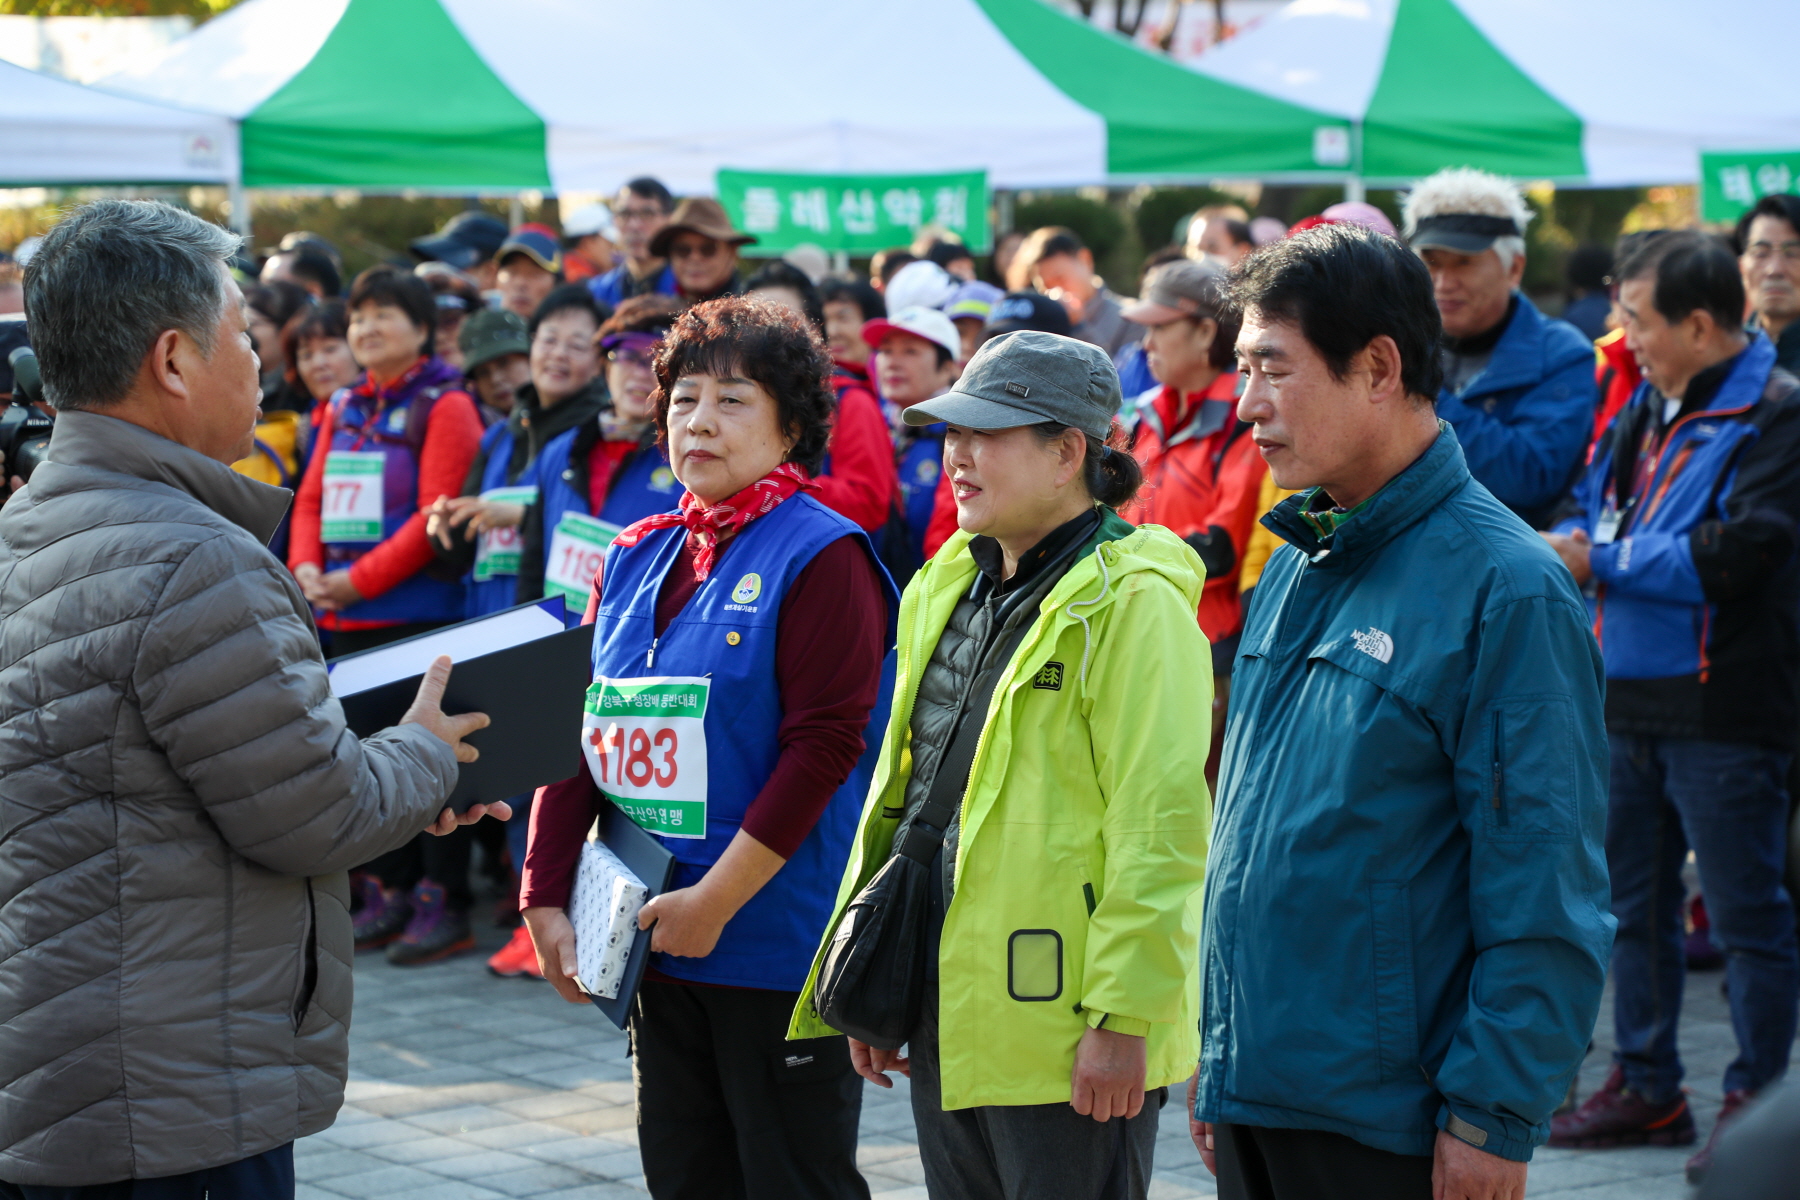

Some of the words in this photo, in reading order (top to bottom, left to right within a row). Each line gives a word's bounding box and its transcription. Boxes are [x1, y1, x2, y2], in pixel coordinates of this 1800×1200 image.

[1350, 629, 1380, 649] NORTH
[1369, 626, 1385, 640] THE
[1353, 641, 1376, 656] FACE
[589, 727, 678, 788] 1183
